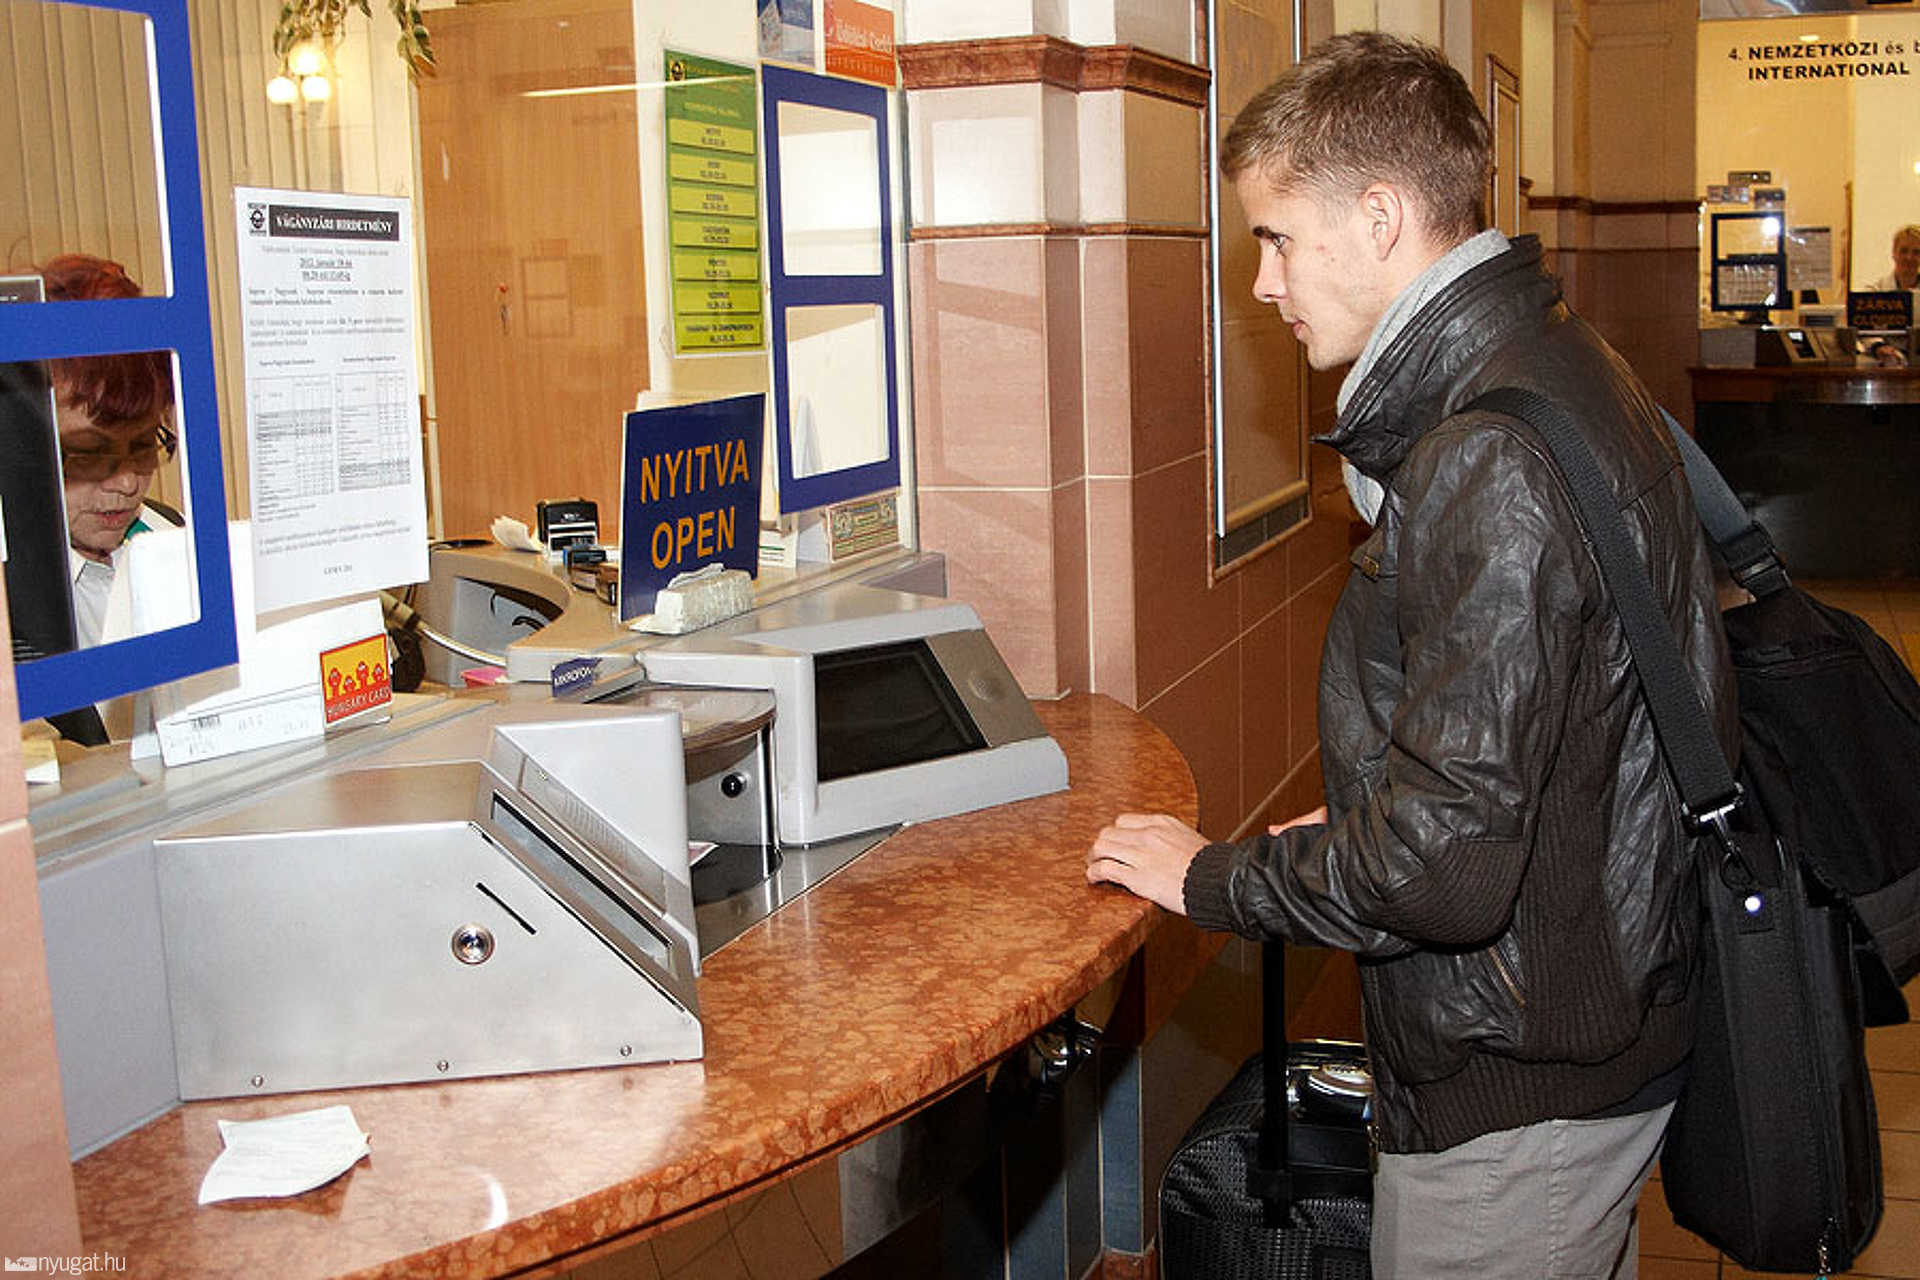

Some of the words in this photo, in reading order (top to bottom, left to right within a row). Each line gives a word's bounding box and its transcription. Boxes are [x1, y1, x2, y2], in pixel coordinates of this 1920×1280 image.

[1727, 47, 1743, 61] 4.
[1884, 41, 1905, 55] és
[1748, 61, 1911, 81] INTERNATIONAL
[640, 438, 750, 504] NYITVA
[651, 505, 735, 569] OPEN
